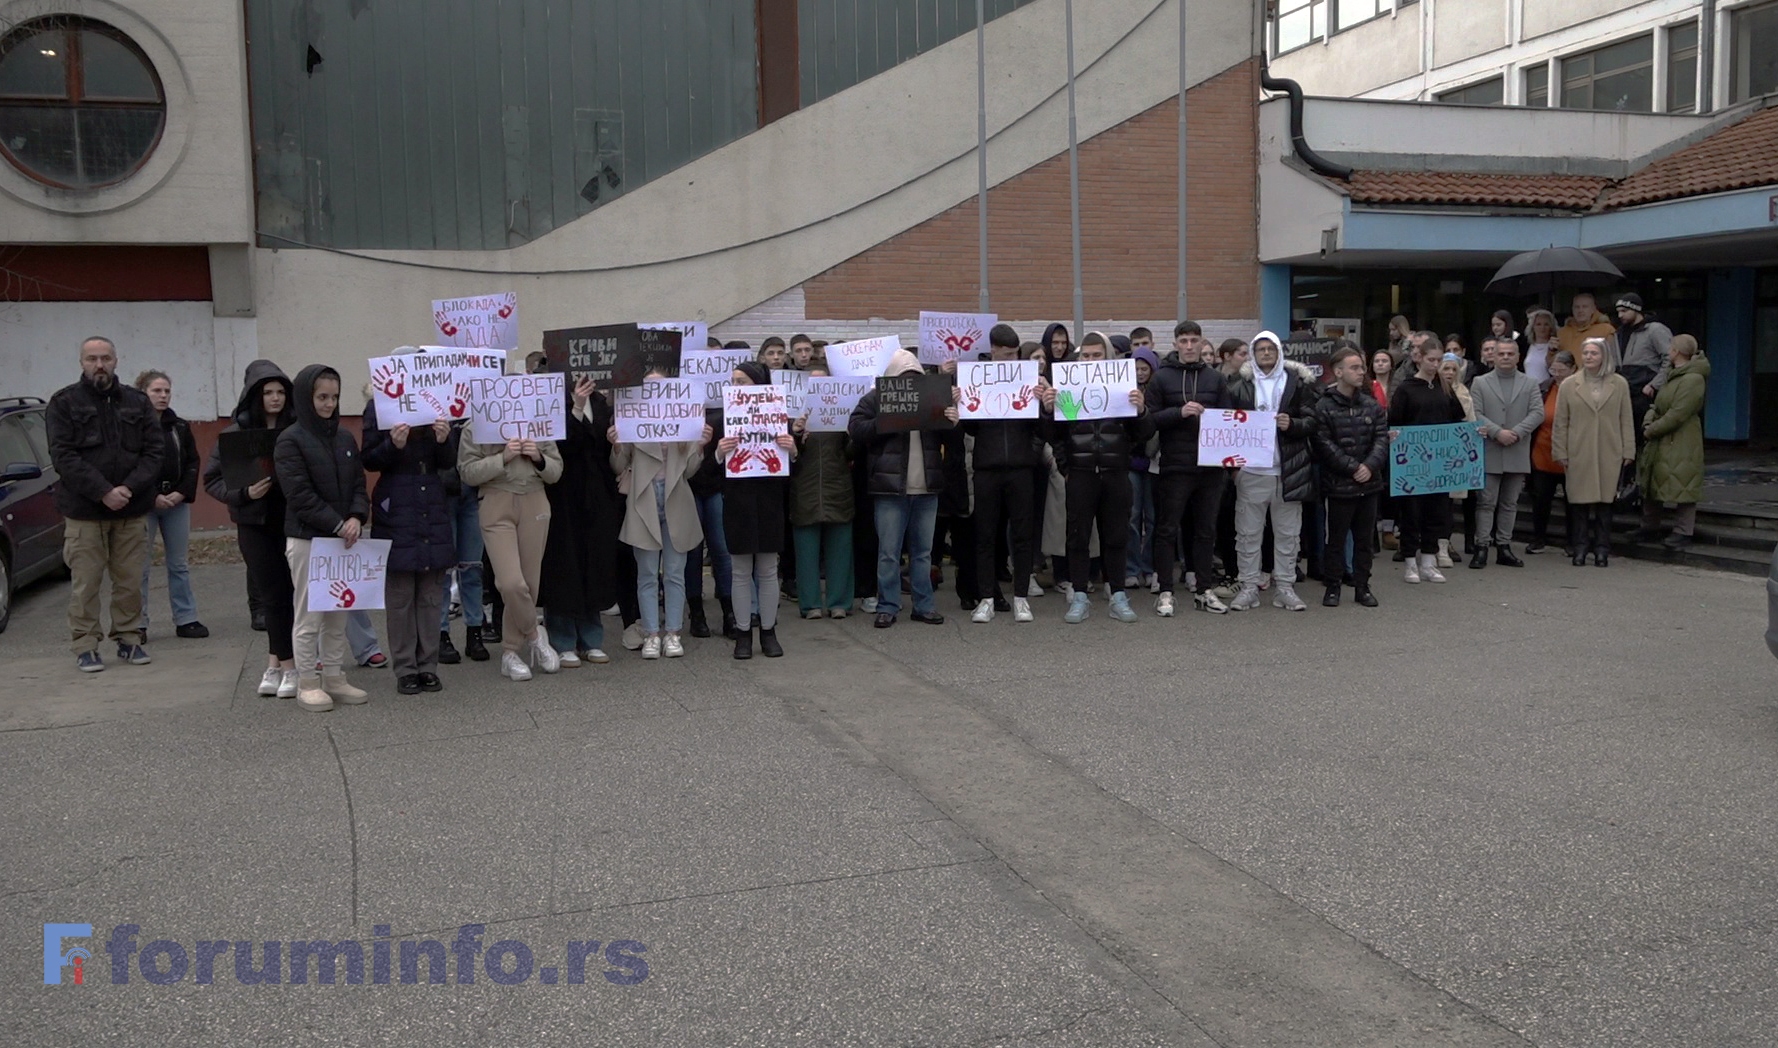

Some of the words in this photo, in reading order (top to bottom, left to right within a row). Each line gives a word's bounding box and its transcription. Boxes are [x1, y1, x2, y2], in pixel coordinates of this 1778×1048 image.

[442, 298, 496, 312] БЛОКАДА
[457, 315, 480, 326] АКО
[488, 314, 501, 324] НЕ
[568, 337, 618, 354] КРИВИ
[390, 358, 408, 374] ЈА
[414, 352, 467, 370] ПРИПАДАМ
[569, 354, 591, 367] СТЕ
[412, 372, 453, 388] МАМИ
[782, 371, 803, 392] НА
[971, 363, 1022, 388] СЕДИ
[1059, 361, 1130, 387] УСТАНИ
[470, 377, 564, 400] ПРОСВЕТА
[616, 388, 633, 400] НЕ
[641, 382, 690, 400] БРИНИ
[880, 378, 914, 392] ВАШЕ
[399, 393, 417, 413] НЕ
[821, 396, 838, 405] ЧАС
[880, 392, 919, 403] ГРЕШКЕ
[984, 392, 1011, 416] (1)
[1081, 386, 1109, 414] (5)
[470, 400, 525, 423] МОРА
[534, 398, 560, 418] ДА
[615, 402, 661, 419] НЕЋЕШ
[662, 402, 706, 420] ДОБИТИ
[747, 406, 760, 414] ЛИ
[726, 416, 749, 426] КАКО
[821, 417, 837, 426] ЧАС
[499, 420, 554, 441] СТАНЕ
[637, 423, 680, 439] ОТКАЗ!
[1200, 428, 1268, 449] ОБРАЗОВАЊЕ
[309, 553, 361, 582] ДРУШТВО
